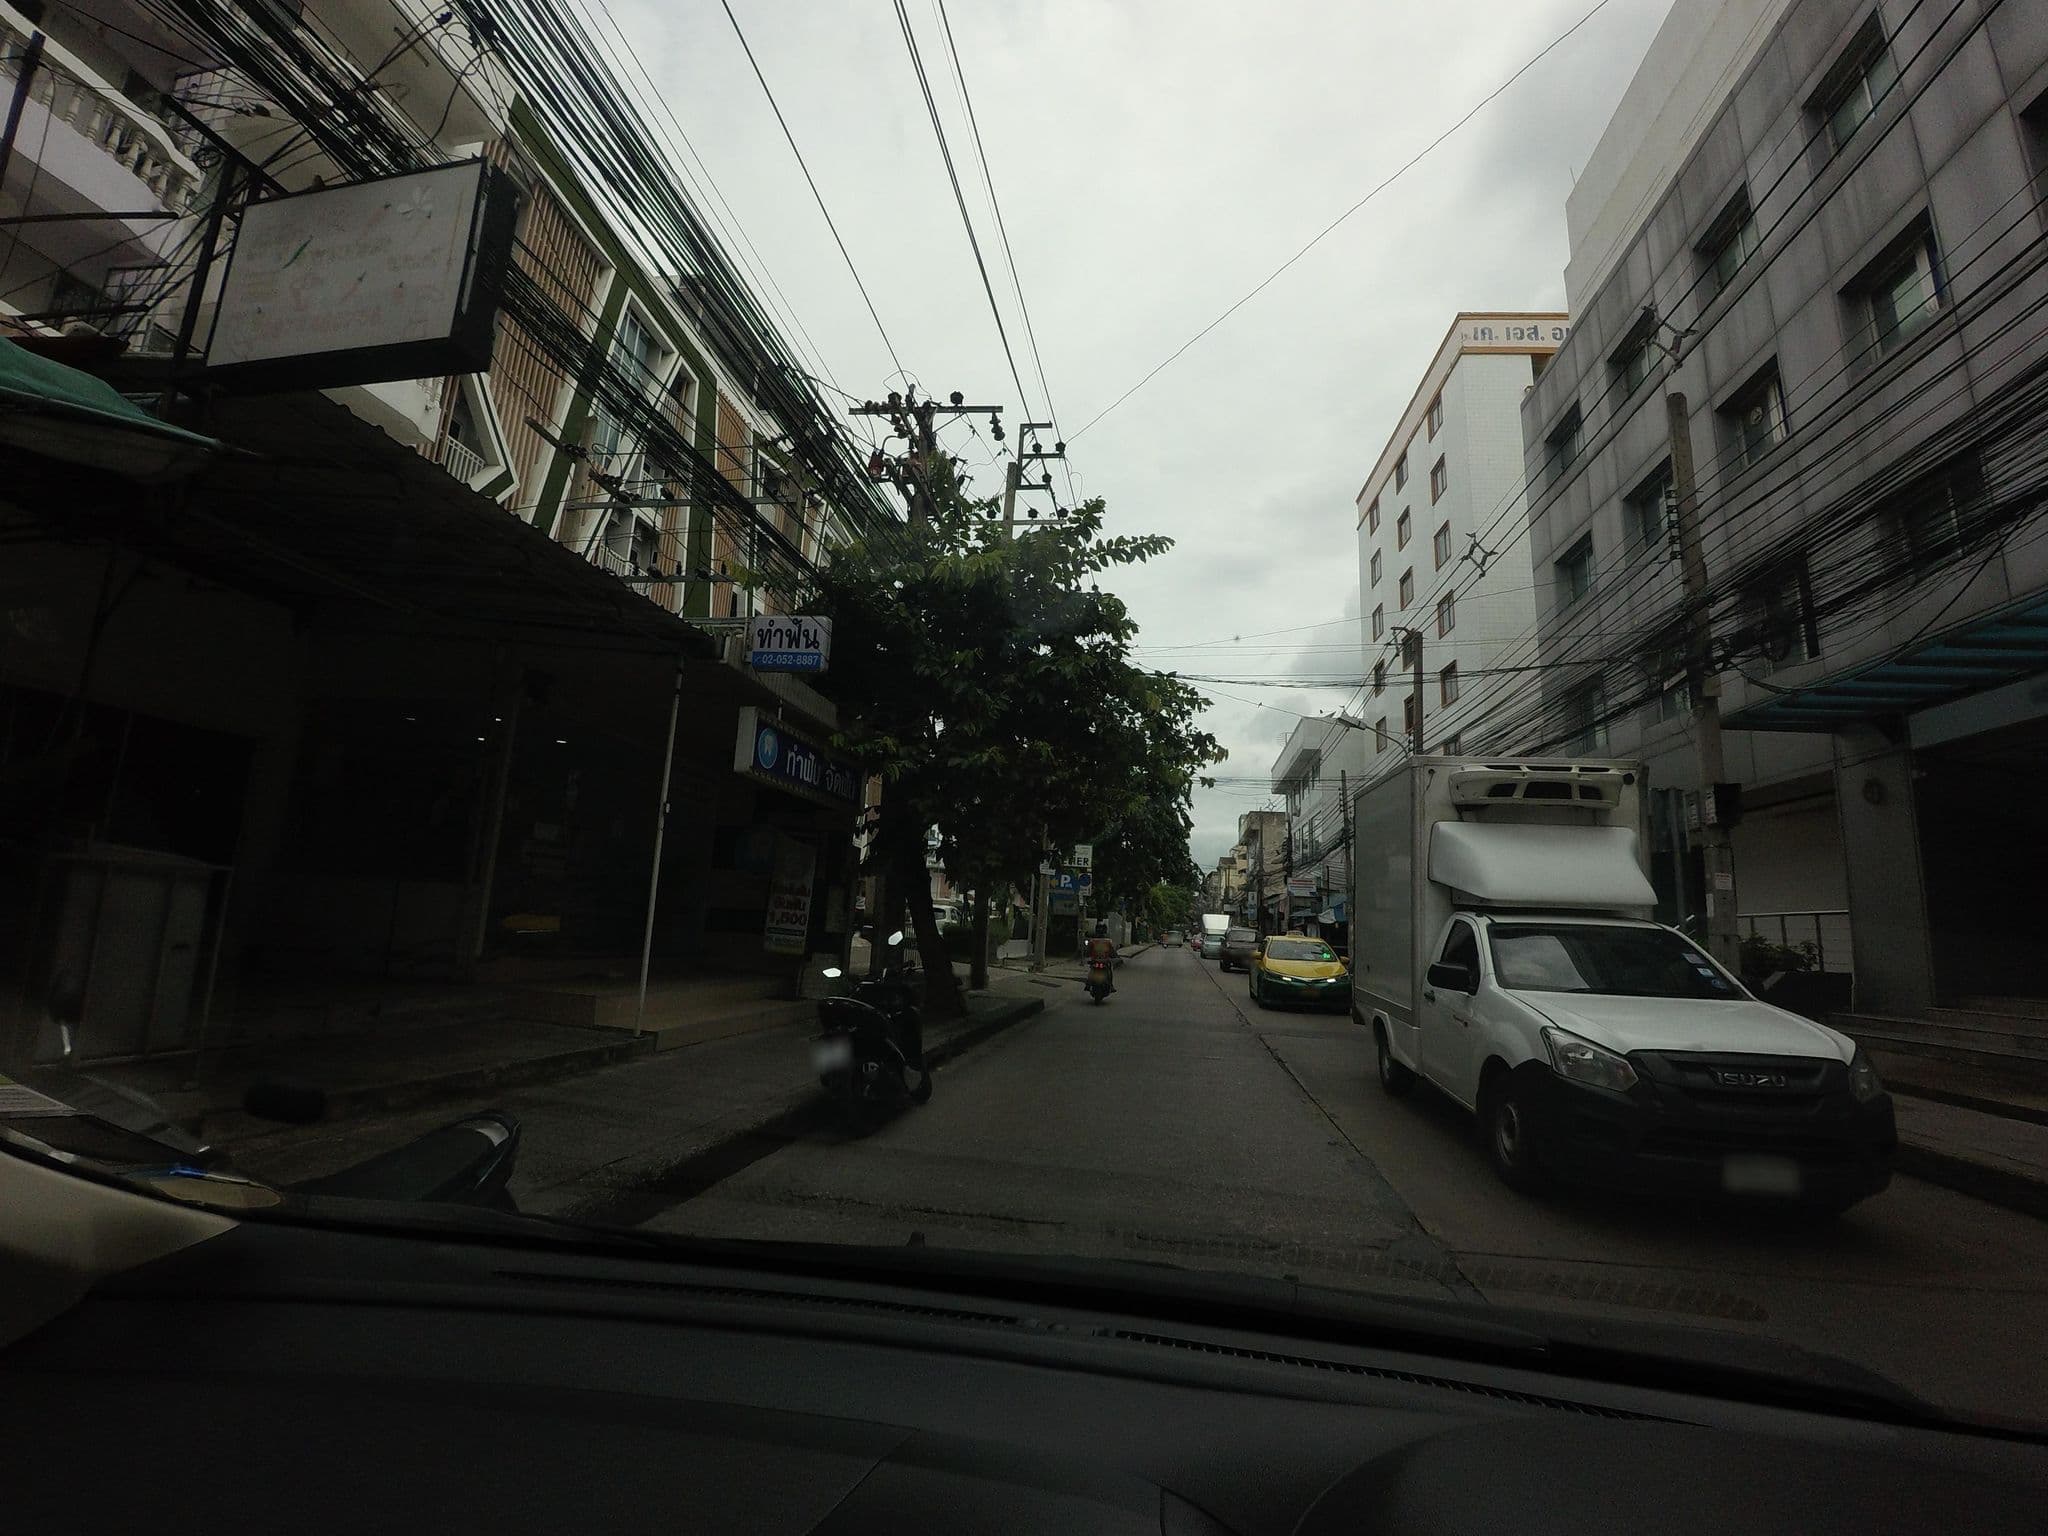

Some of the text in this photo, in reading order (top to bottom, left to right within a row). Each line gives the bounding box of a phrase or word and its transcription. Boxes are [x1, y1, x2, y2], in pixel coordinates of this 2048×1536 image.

[757, 618, 819, 650] ทำฟัน
[761, 654, 820, 666] 02-052-8887
[1715, 1071, 1788, 1088] ISUZU
